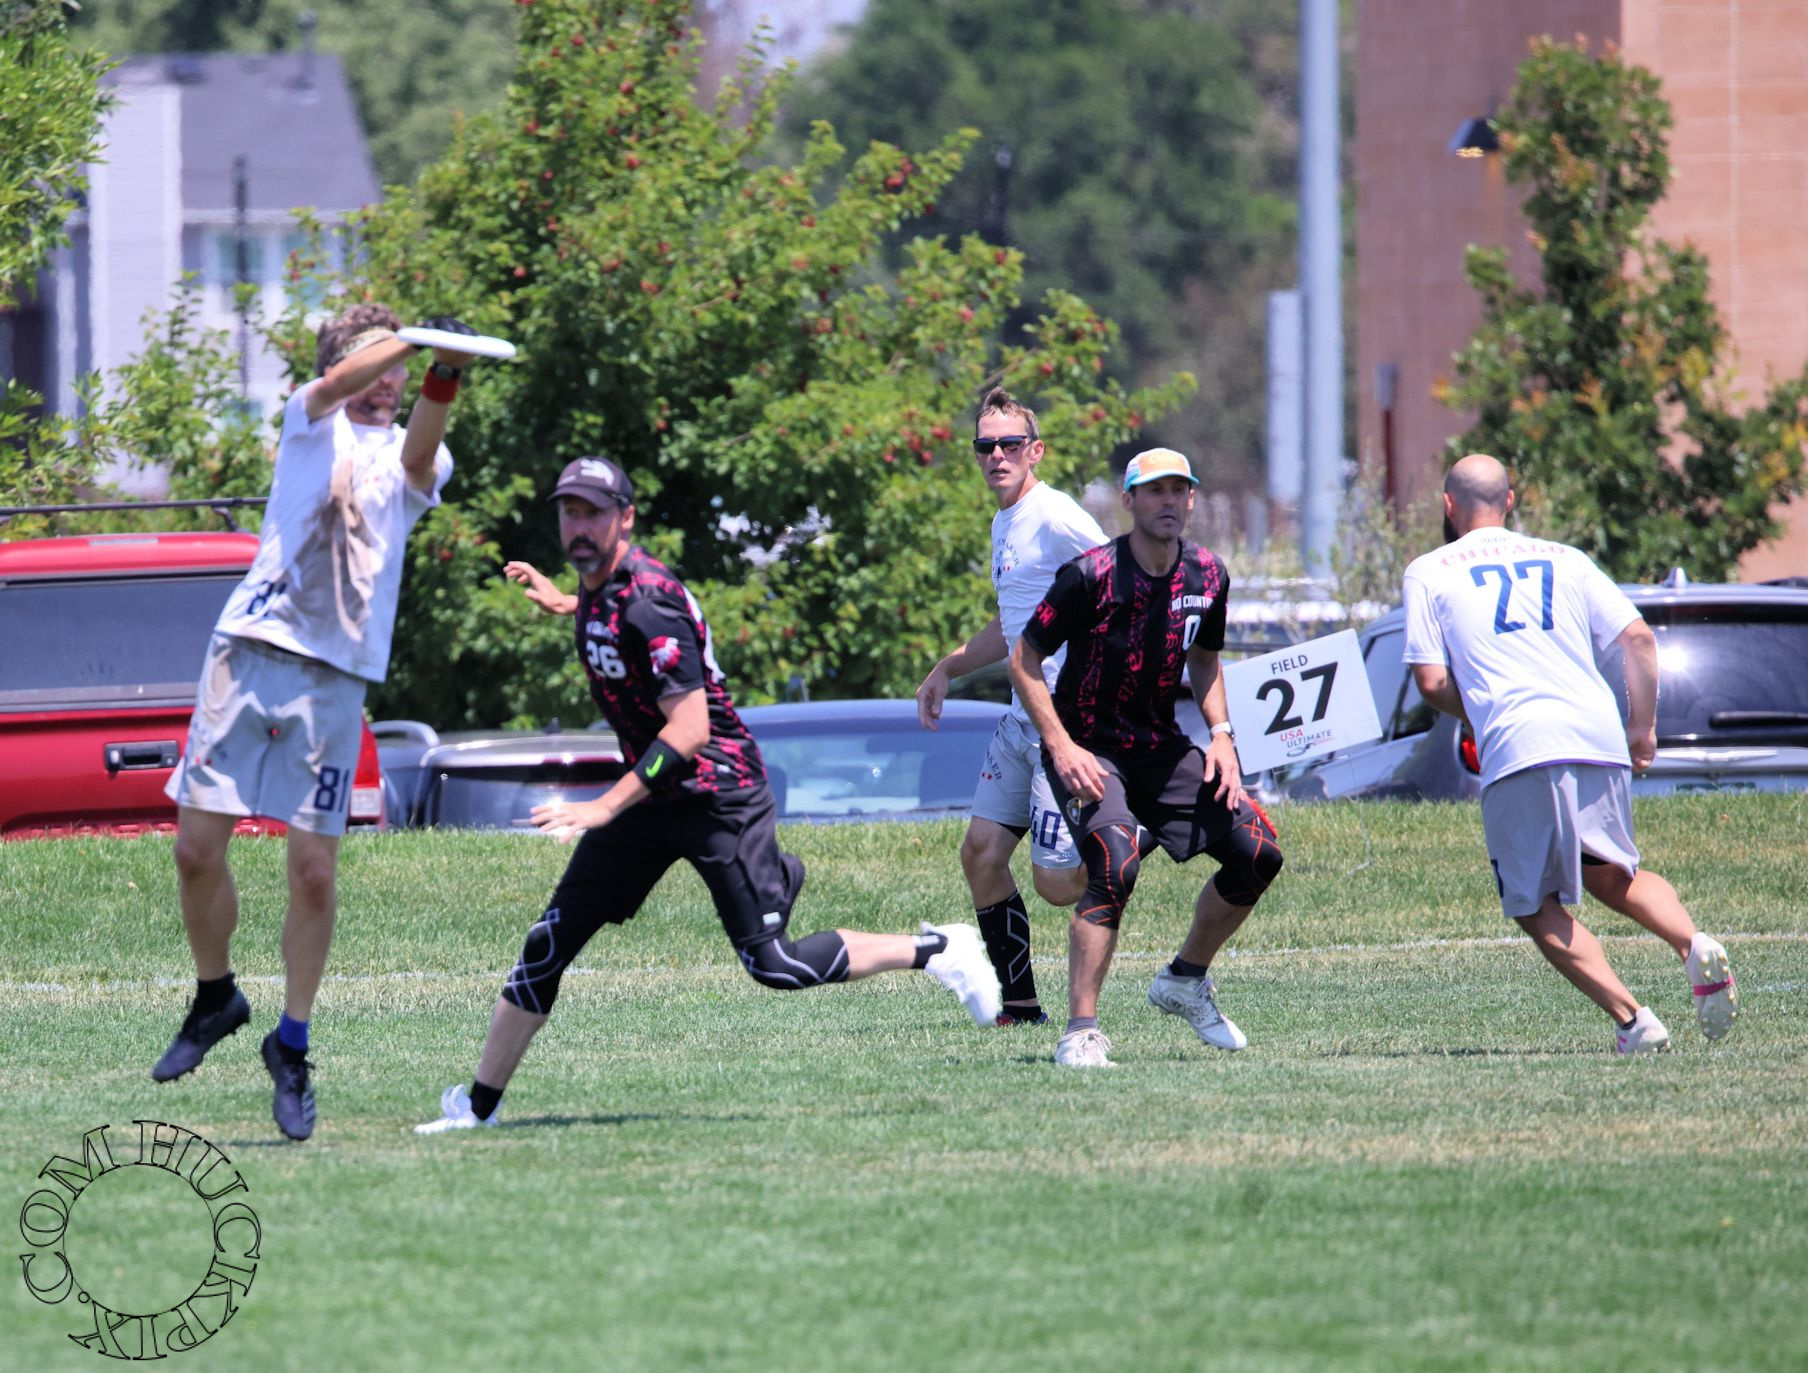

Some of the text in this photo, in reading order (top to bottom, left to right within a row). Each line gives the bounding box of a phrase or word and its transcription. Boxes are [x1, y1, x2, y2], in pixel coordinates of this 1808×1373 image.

[1469, 558, 1555, 635] 27
[1271, 654, 1309, 675] FIELD
[1255, 660, 1339, 736] 27
[1279, 728, 1304, 742] USA
[1286, 728, 1333, 749] ULTIMATE
[313, 765, 350, 813] 81
[1030, 804, 1062, 850] 40
